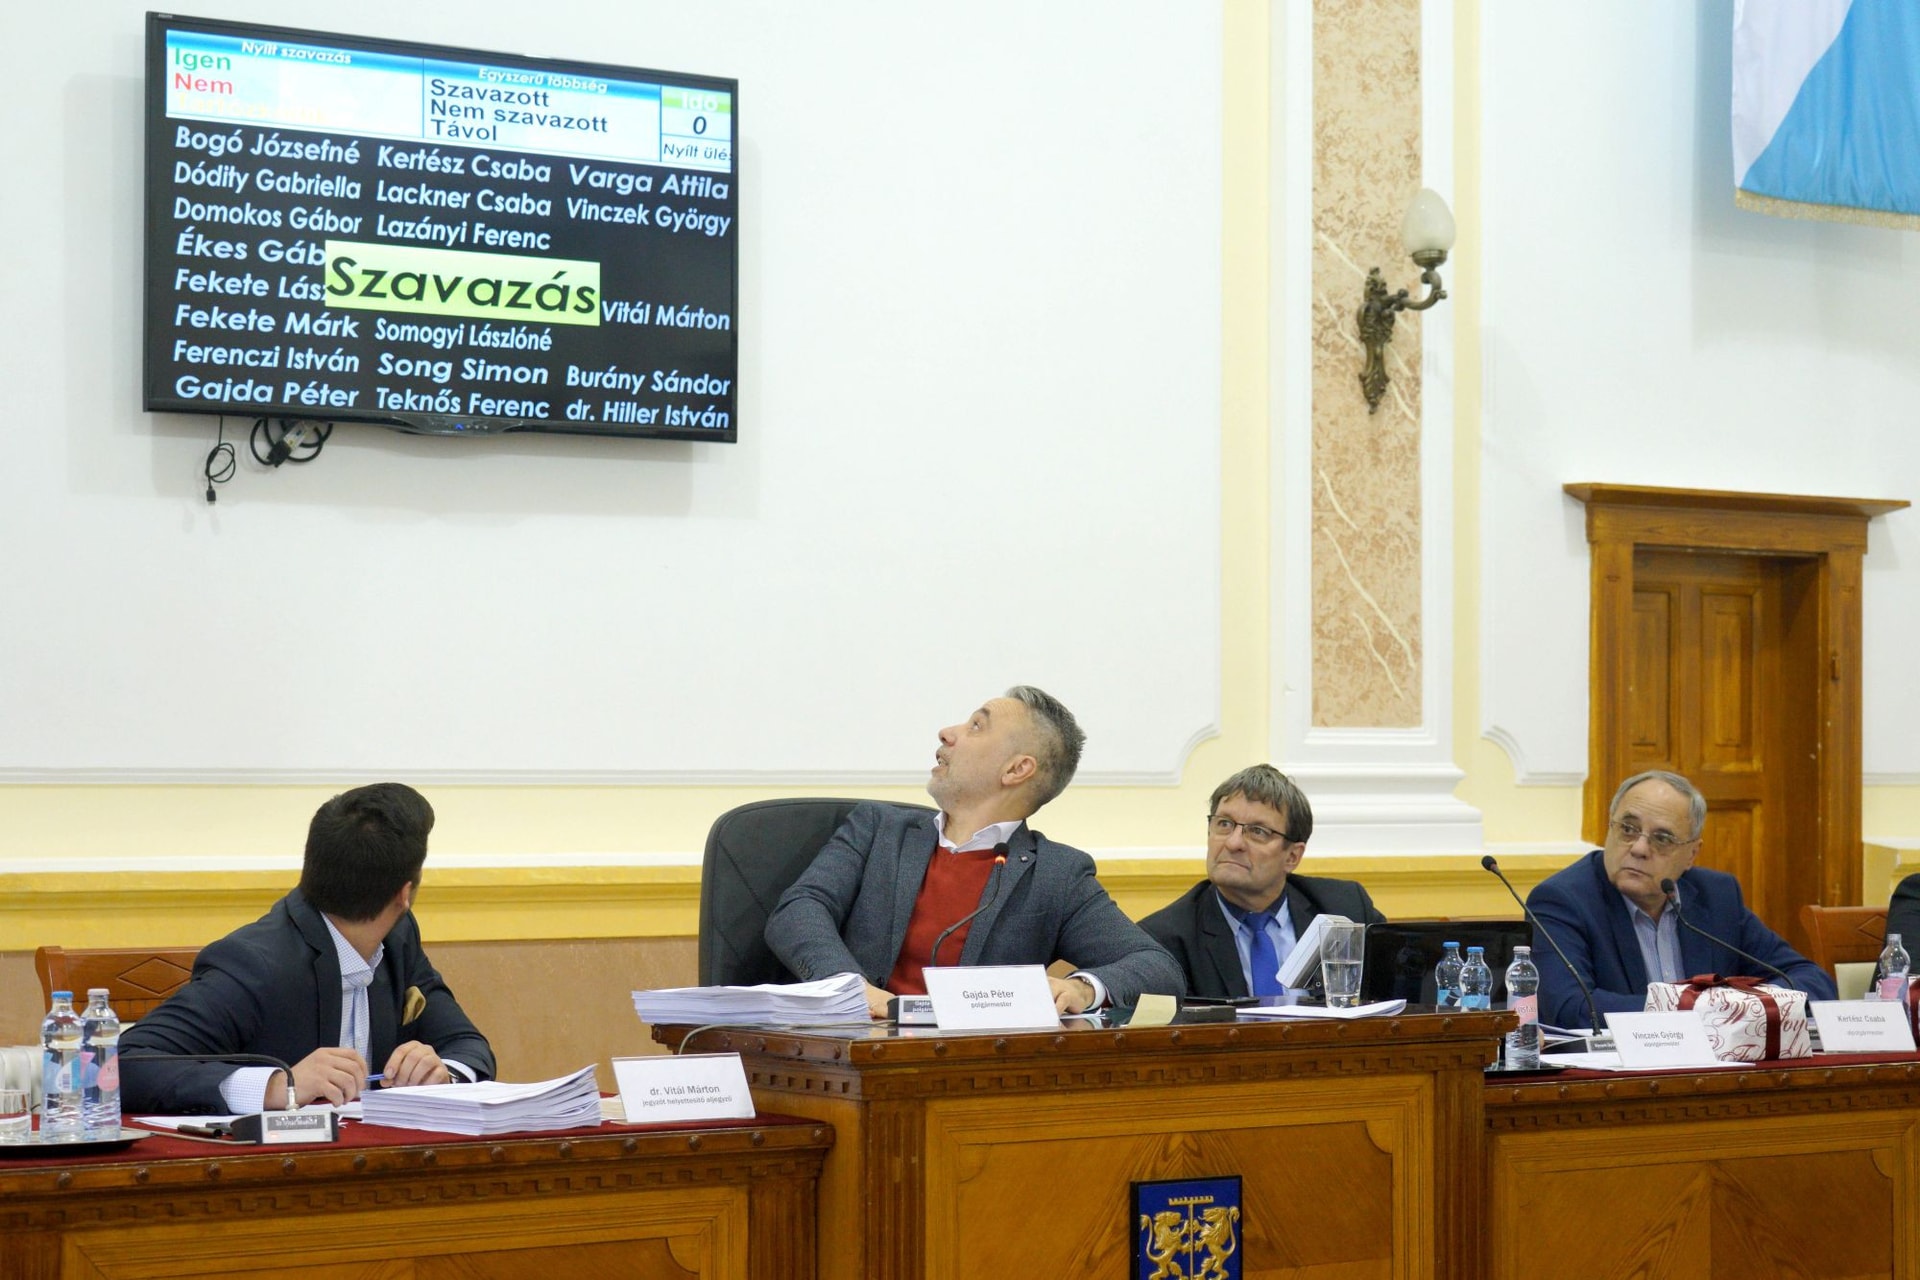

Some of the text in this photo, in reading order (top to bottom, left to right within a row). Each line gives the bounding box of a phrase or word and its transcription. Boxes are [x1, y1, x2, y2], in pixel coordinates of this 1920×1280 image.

[175, 48, 231, 71] Igen
[281, 47, 352, 64] szavazás
[174, 72, 233, 95] Nem
[430, 79, 550, 107] Szavazott
[547, 75, 608, 95] többség
[430, 99, 608, 133] Nem szavazott
[430, 118, 497, 142] Távol
[693, 115, 707, 135] 0
[175, 126, 360, 165] Bogó Józsefné
[664, 143, 698, 158] Nyílt
[174, 161, 361, 199] Dódity Gabriella
[377, 145, 551, 183] Kertész Csaba
[569, 163, 729, 200] Varga Attila
[377, 180, 551, 217] Lackner Csaba
[173, 197, 362, 234] Domokos Gábor
[567, 197, 731, 237] Vinczek György
[176, 226, 248, 260] Ékes
[377, 214, 551, 251] Lazányi Ferenc
[174, 269, 270, 297] Fekete
[326, 256, 597, 314] Szavazás
[175, 304, 360, 338] Fekete Márk
[602, 300, 731, 331] Vitál Márton
[374, 317, 552, 351] Somogyi Lászlóné
[173, 340, 360, 373] Ferenczi István
[377, 352, 549, 385] Song Simon
[175, 375, 360, 408] Gajda Péter
[565, 365, 731, 396] Burány Sándor
[376, 387, 550, 419] Teknős Ferenc
[565, 400, 730, 429] dr. Hiller István
[962, 989, 1014, 1001] Gajda Péter
[649, 1084, 720, 1096] dr. Vitál Márton
